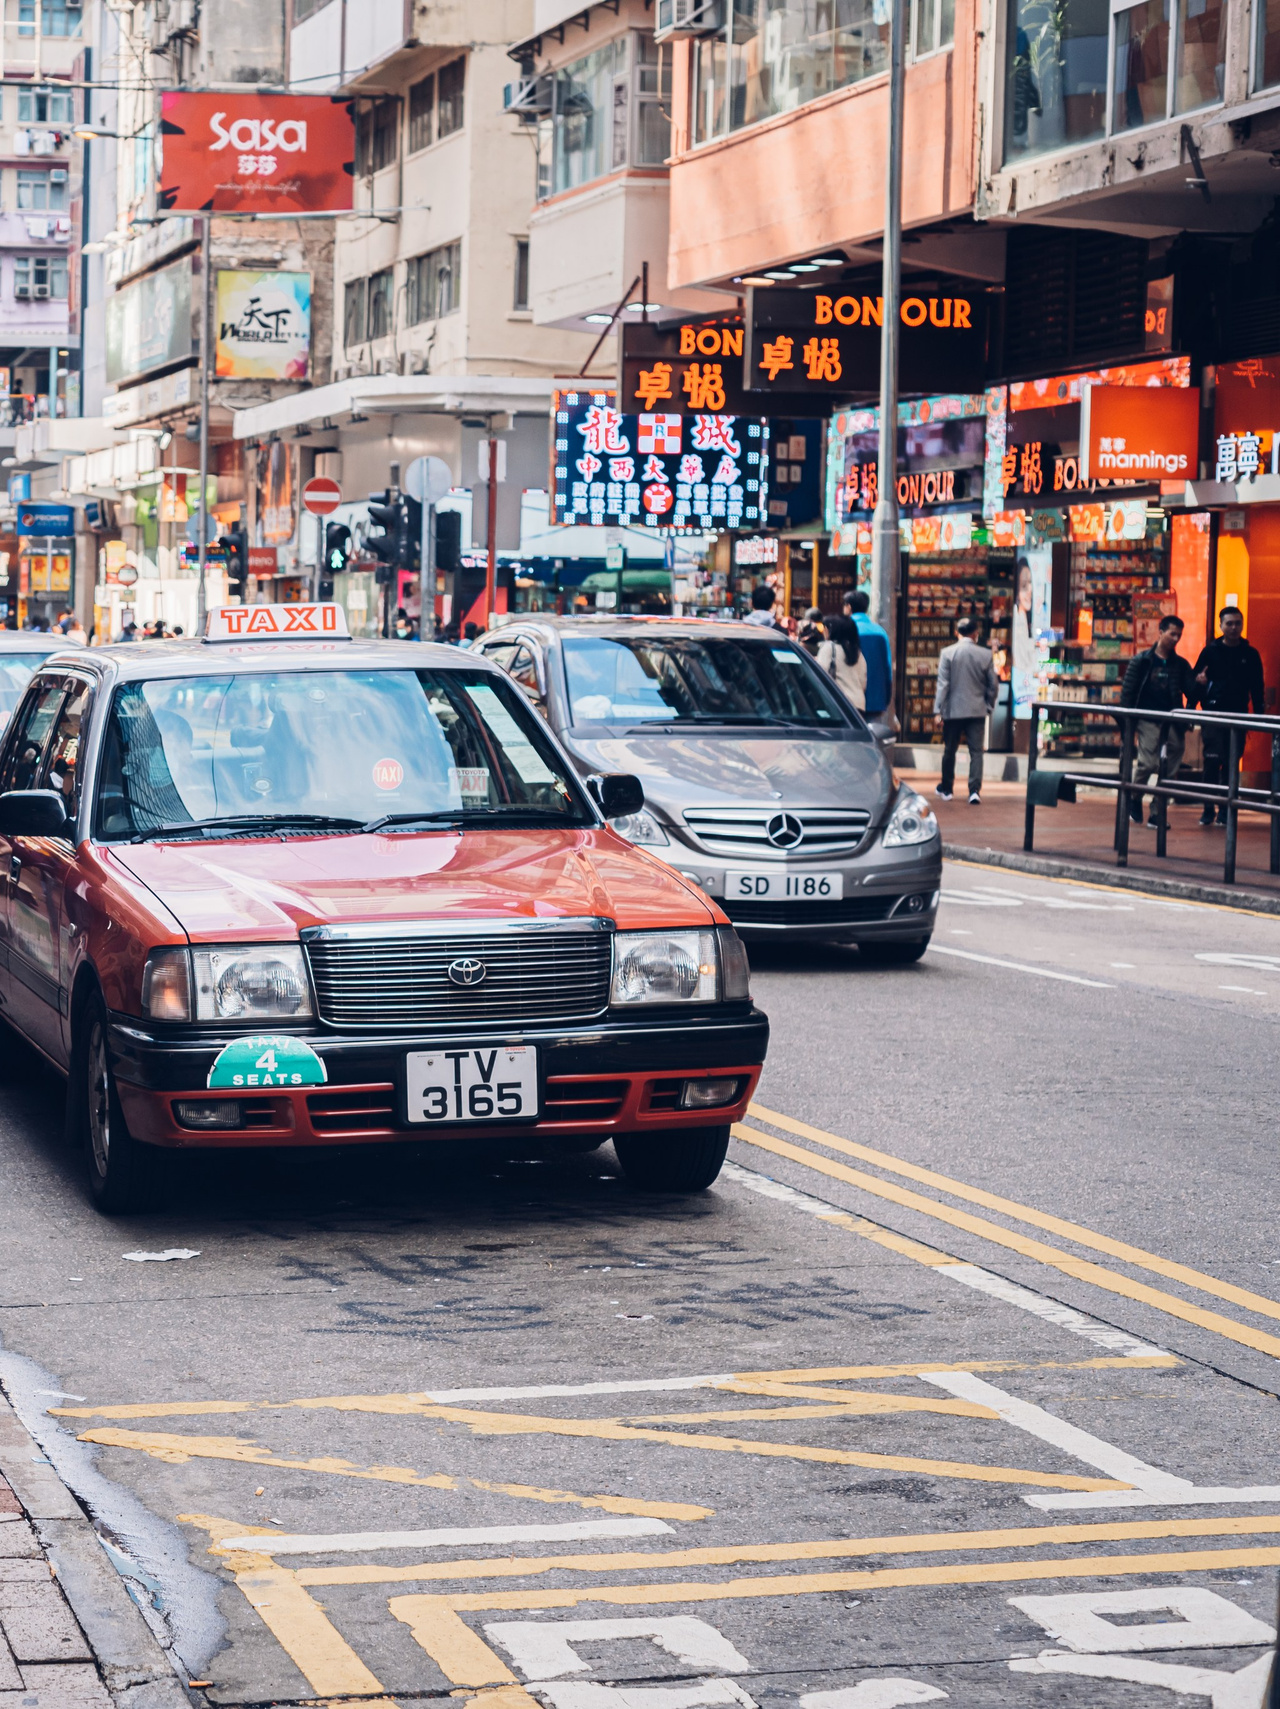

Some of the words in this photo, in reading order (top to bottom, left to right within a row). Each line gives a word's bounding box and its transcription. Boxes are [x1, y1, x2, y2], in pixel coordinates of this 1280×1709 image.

[238, 155, 277, 175] 莎莎
[243, 297, 291, 338] 天下
[815, 295, 972, 328] BONOUR
[577, 405, 630, 454] 龍
[1098, 450, 1187, 473] mannings
[1216, 431, 1260, 483] 萬寧
[895, 471, 955, 508] ONJOUR
[221, 606, 337, 633] TAXI
[375, 767, 401, 782] TAXI
[455, 776, 486, 791] TAXI
[739, 877, 770, 895] SD
[786, 877, 831, 896] 1186
[245, 1037, 290, 1049] TAXI
[256, 1052, 278, 1072] 4
[445, 1050, 497, 1085] TV
[233, 1073, 302, 1085] SEATS
[423, 1082, 522, 1119] 3165
